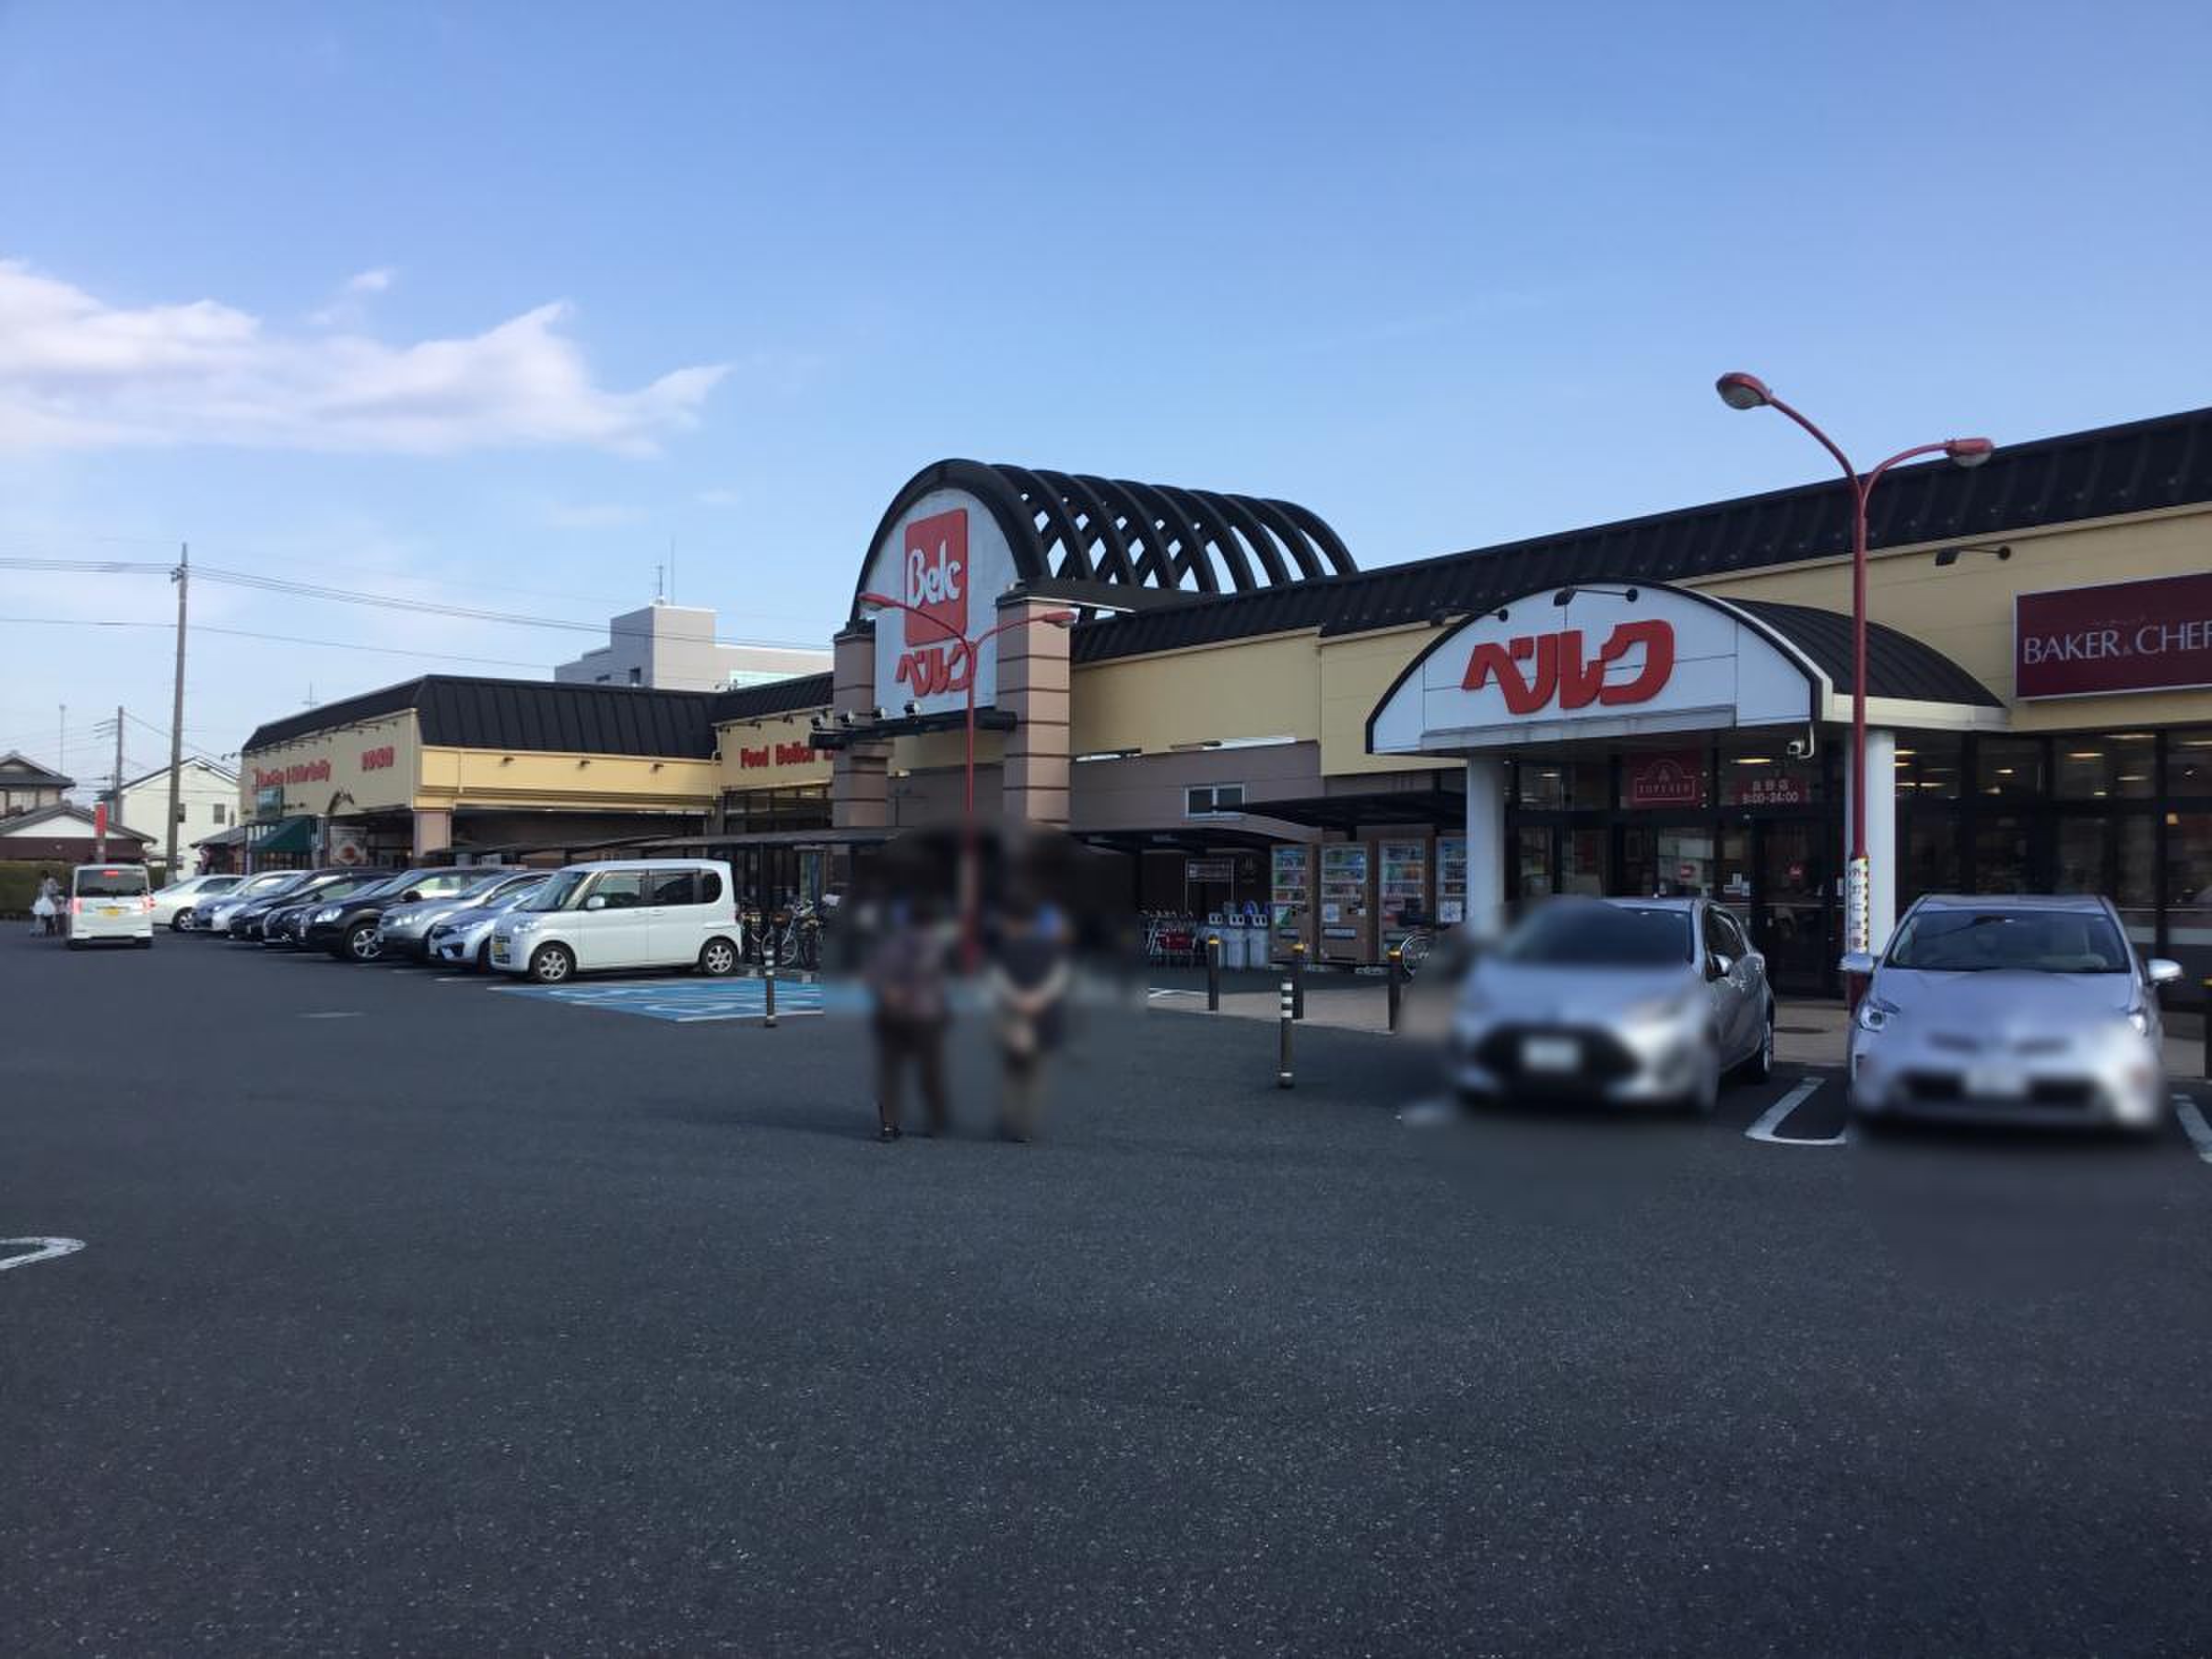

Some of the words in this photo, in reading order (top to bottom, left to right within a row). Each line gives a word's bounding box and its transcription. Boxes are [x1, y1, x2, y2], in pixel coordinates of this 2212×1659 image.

[907, 538, 961, 609] Belc
[896, 642, 977, 698] ベルク
[1461, 618, 1675, 715] ベルク
[2023, 629, 2121, 665] BAKER
